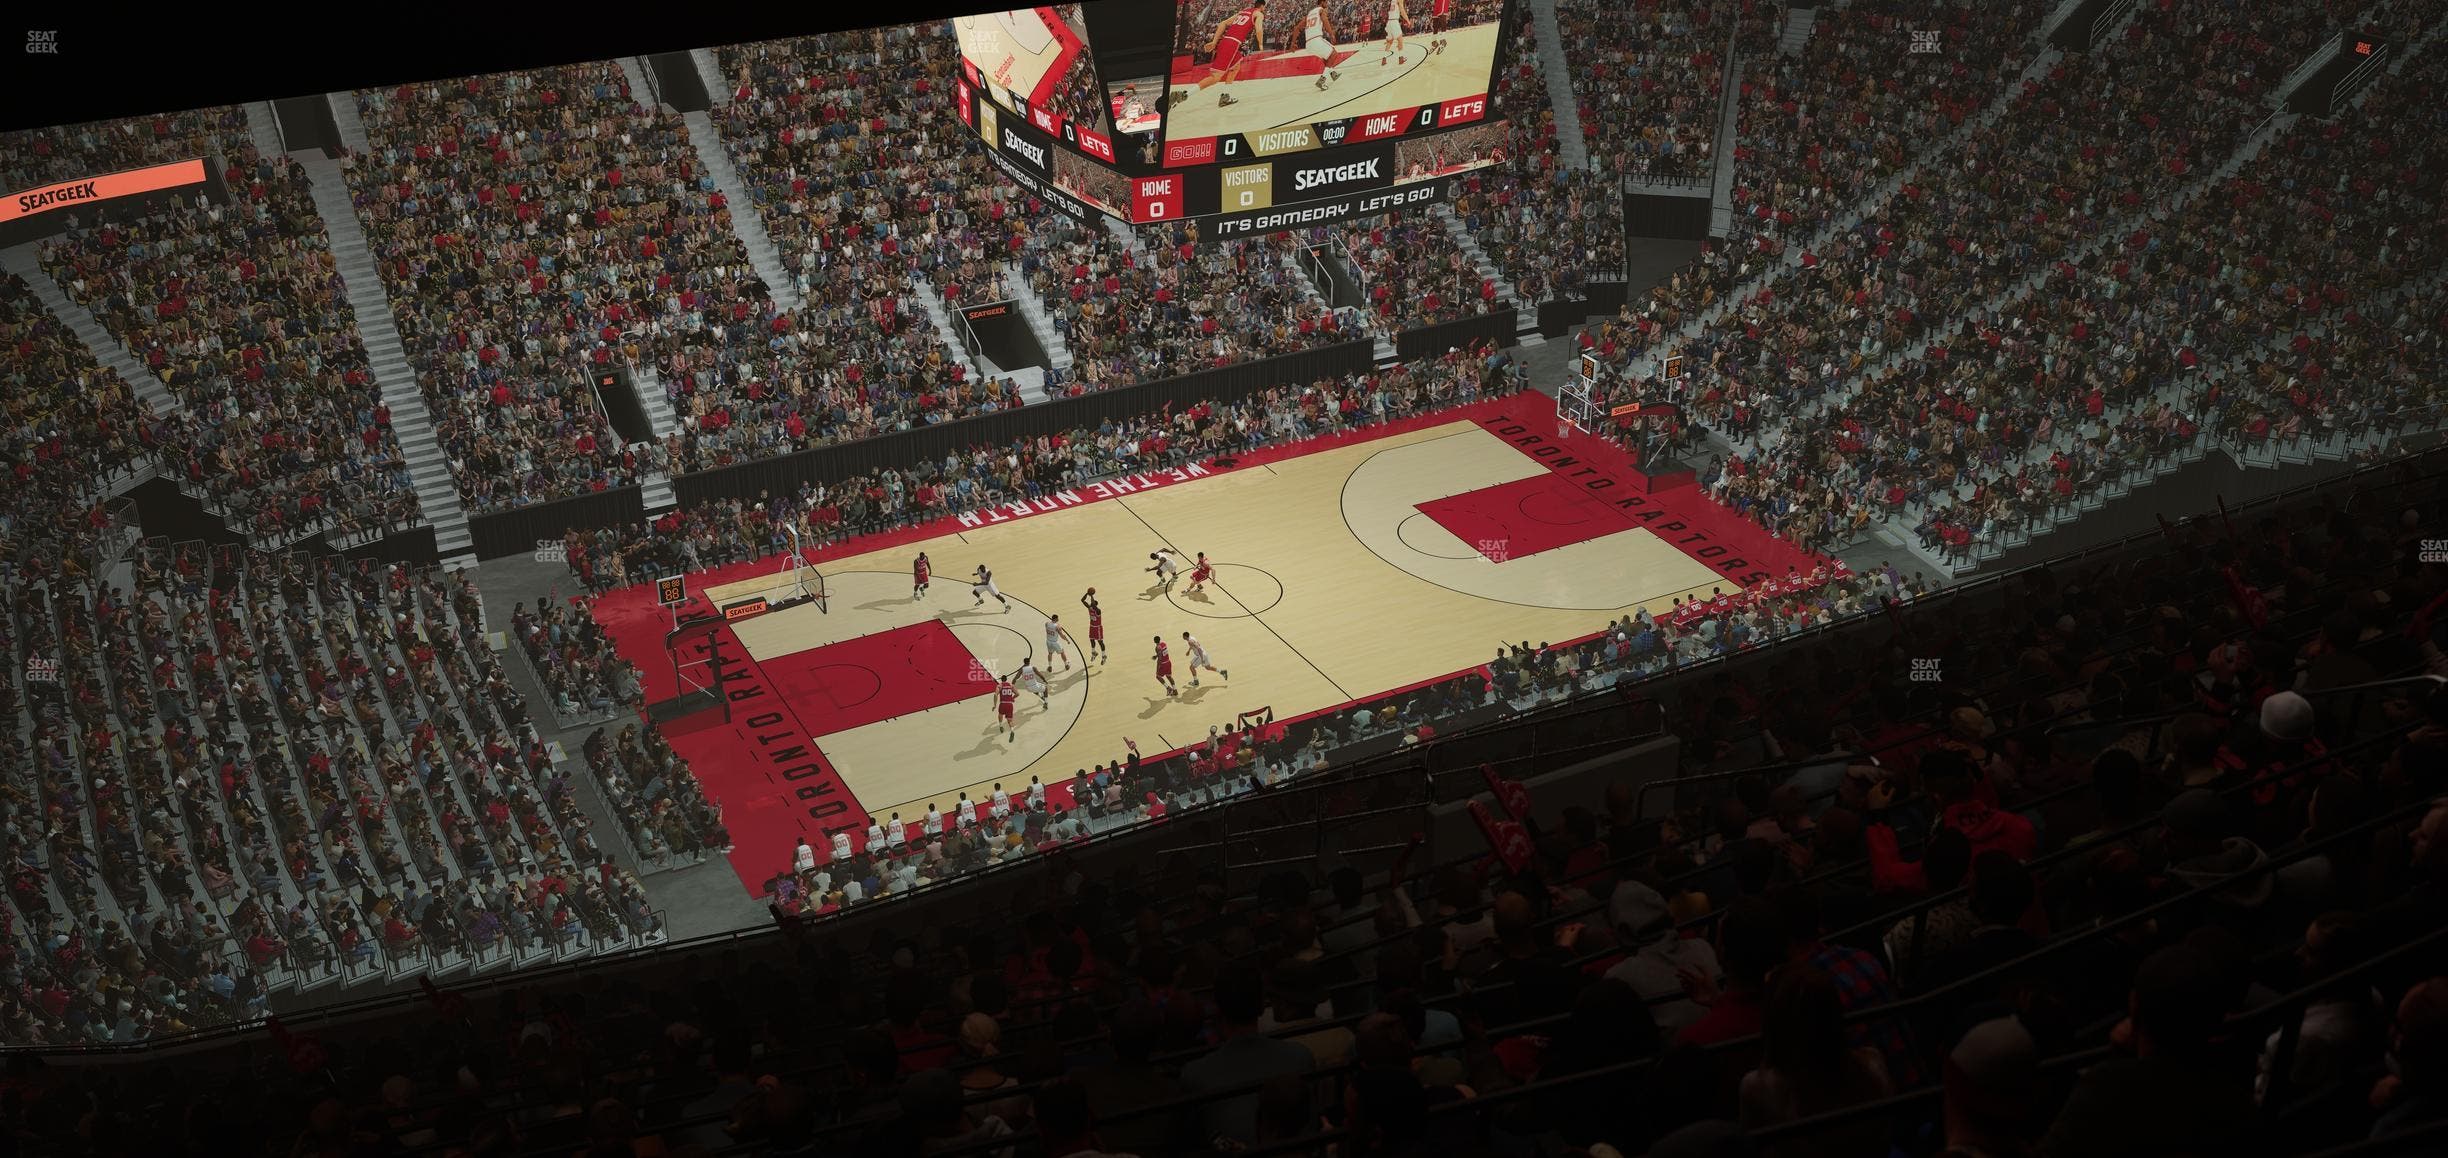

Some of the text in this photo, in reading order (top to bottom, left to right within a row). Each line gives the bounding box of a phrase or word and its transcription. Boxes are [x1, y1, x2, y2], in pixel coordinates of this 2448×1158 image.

[1170, 101, 1483, 161] GO!!! 0 VISITORS 00:00 HOME 0 LET'S
[1004, 127, 1046, 171] SEATGEEK
[1080, 133, 1110, 156] LET'S
[1225, 168, 1269, 187] VISITORS
[1295, 157, 1380, 191] SEATGEEK
[19, 182, 98, 213] SEATGEEK
[1141, 179, 1172, 197] HOME
[1240, 190, 1254, 207] 0
[1041, 185, 1067, 209] LET'S
[1066, 200, 1085, 219] GO!
[1150, 201, 1164, 218] 0
[1217, 186, 1435, 235] IT'S GAMEDAY LET'S GO!
[968, 305, 1007, 320] SEATGEEK
[1092, 472, 1159, 498] THE
[955, 490, 1083, 528] NORTH
[1485, 415, 1770, 587] TORONTO RAPTORS
[665, 587, 680, 601] 88
[729, 602, 764, 617] SEATGEEK
[1001, 688, 1013, 696] 00
[746, 711, 861, 839] TORONTO
[889, 825, 901, 833] 00
[836, 840, 848, 849] 00
